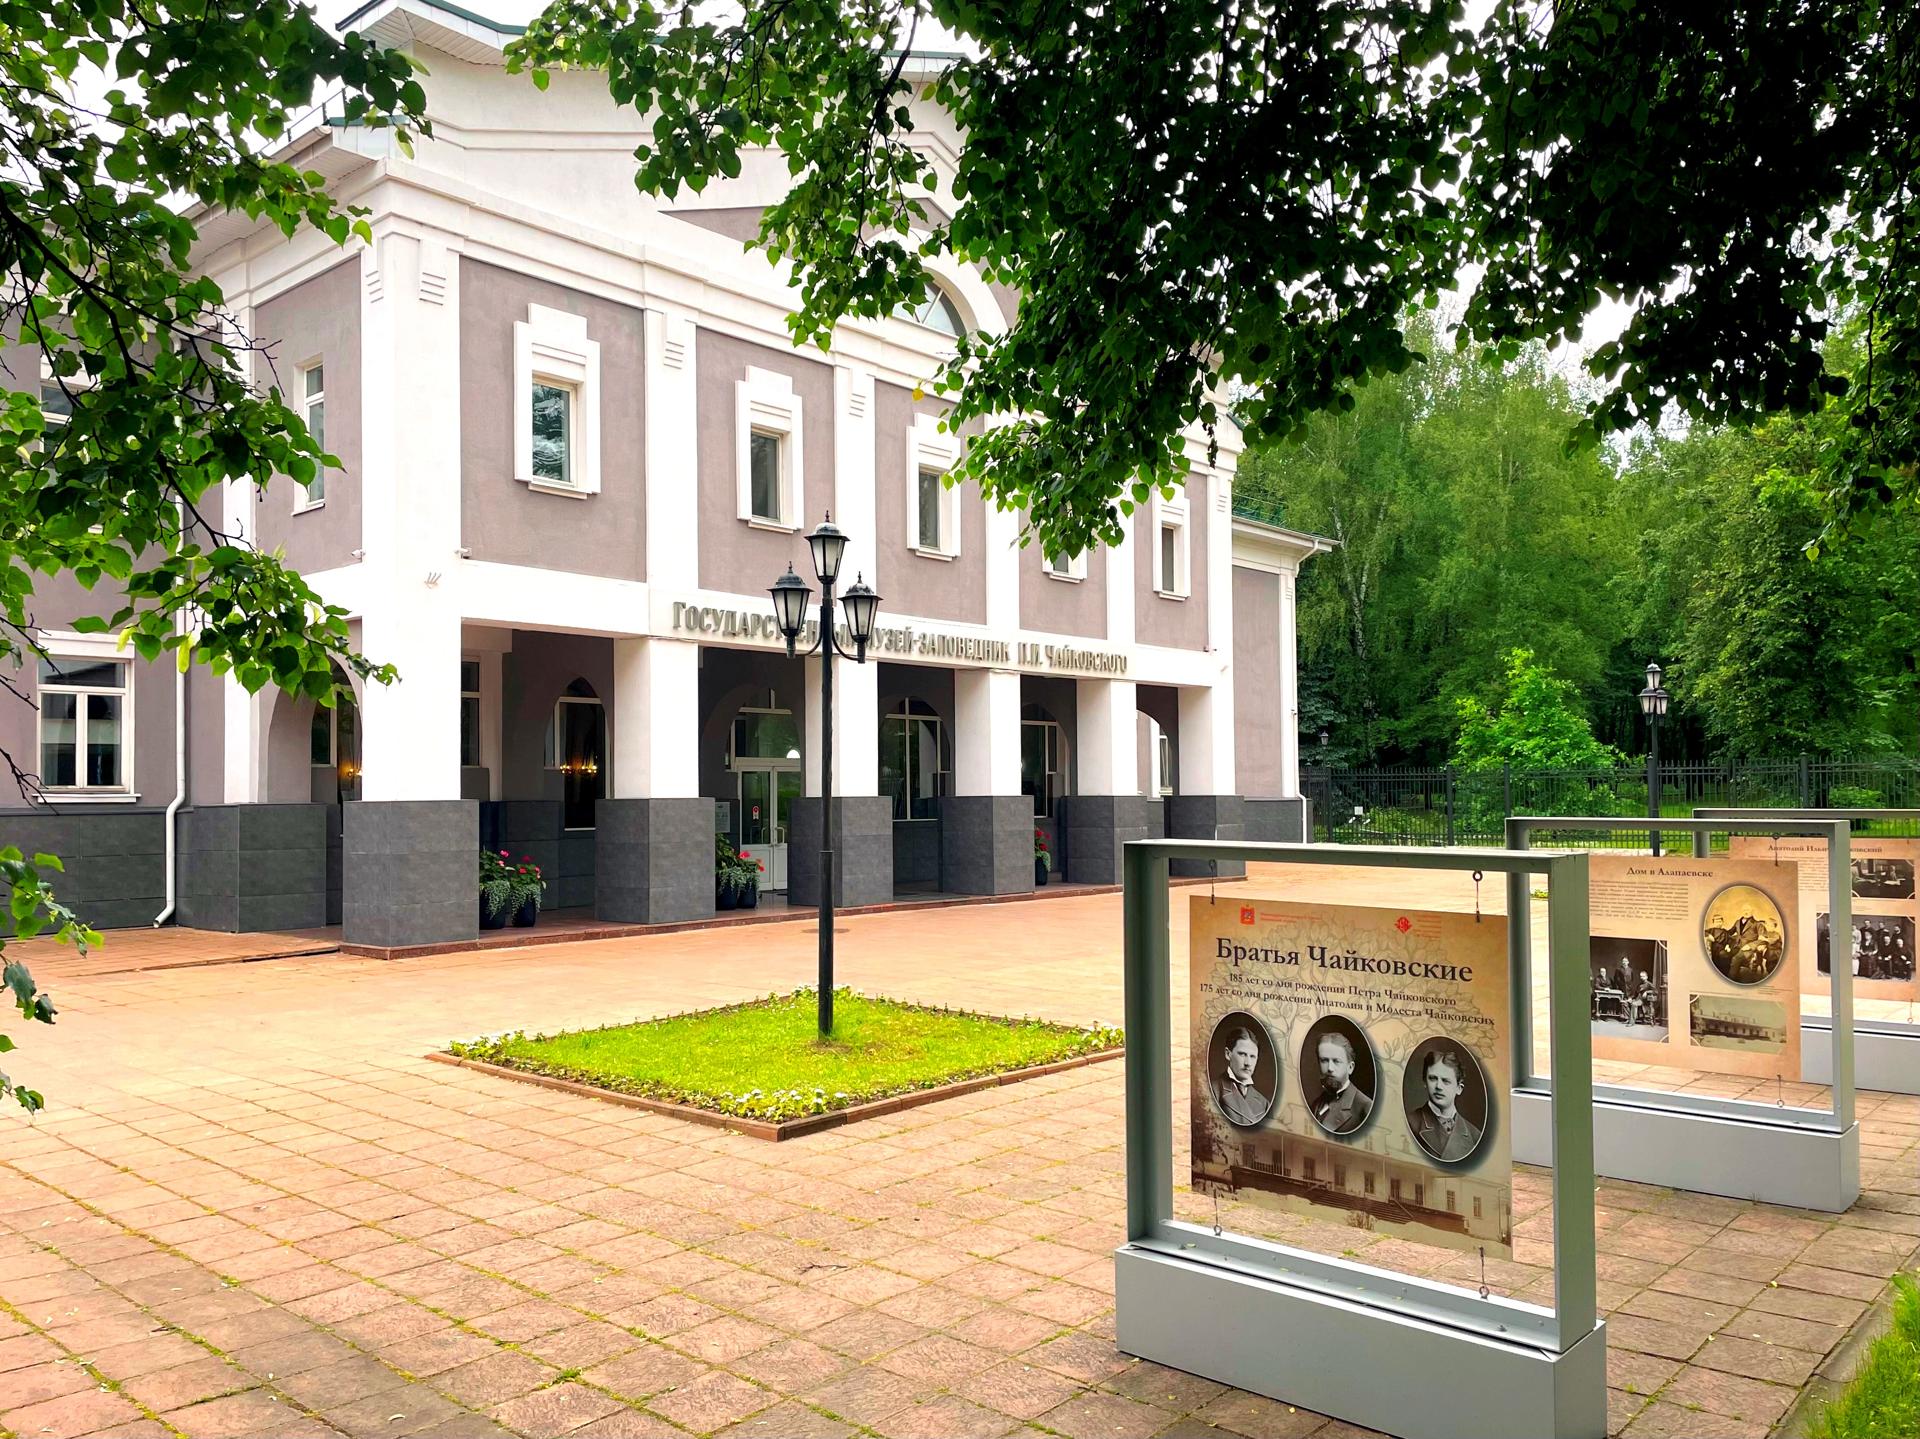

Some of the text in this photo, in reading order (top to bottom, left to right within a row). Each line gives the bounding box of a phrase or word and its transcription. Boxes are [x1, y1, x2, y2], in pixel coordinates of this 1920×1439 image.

[1018, 641, 1043, 665] П.И.
[1046, 644, 1127, 673] ЧАЙКОВСКОГО
[1626, 867, 1646, 876] Дом
[1658, 867, 1713, 877] Алапаевске
[1216, 937, 1473, 983] Братья Чайковские
[1200, 983, 1495, 1026] 175 лет со дня рождения Анатолия и Модеста Чайковских
[1230, 973, 1243, 983] 185
[1245, 977, 1260, 985] лет
[1275, 980, 1292, 989] дня
[1295, 981, 1345, 994] рождения
[1349, 985, 1381, 999] Петра
[1384, 989, 1456, 1006] Чайковского
